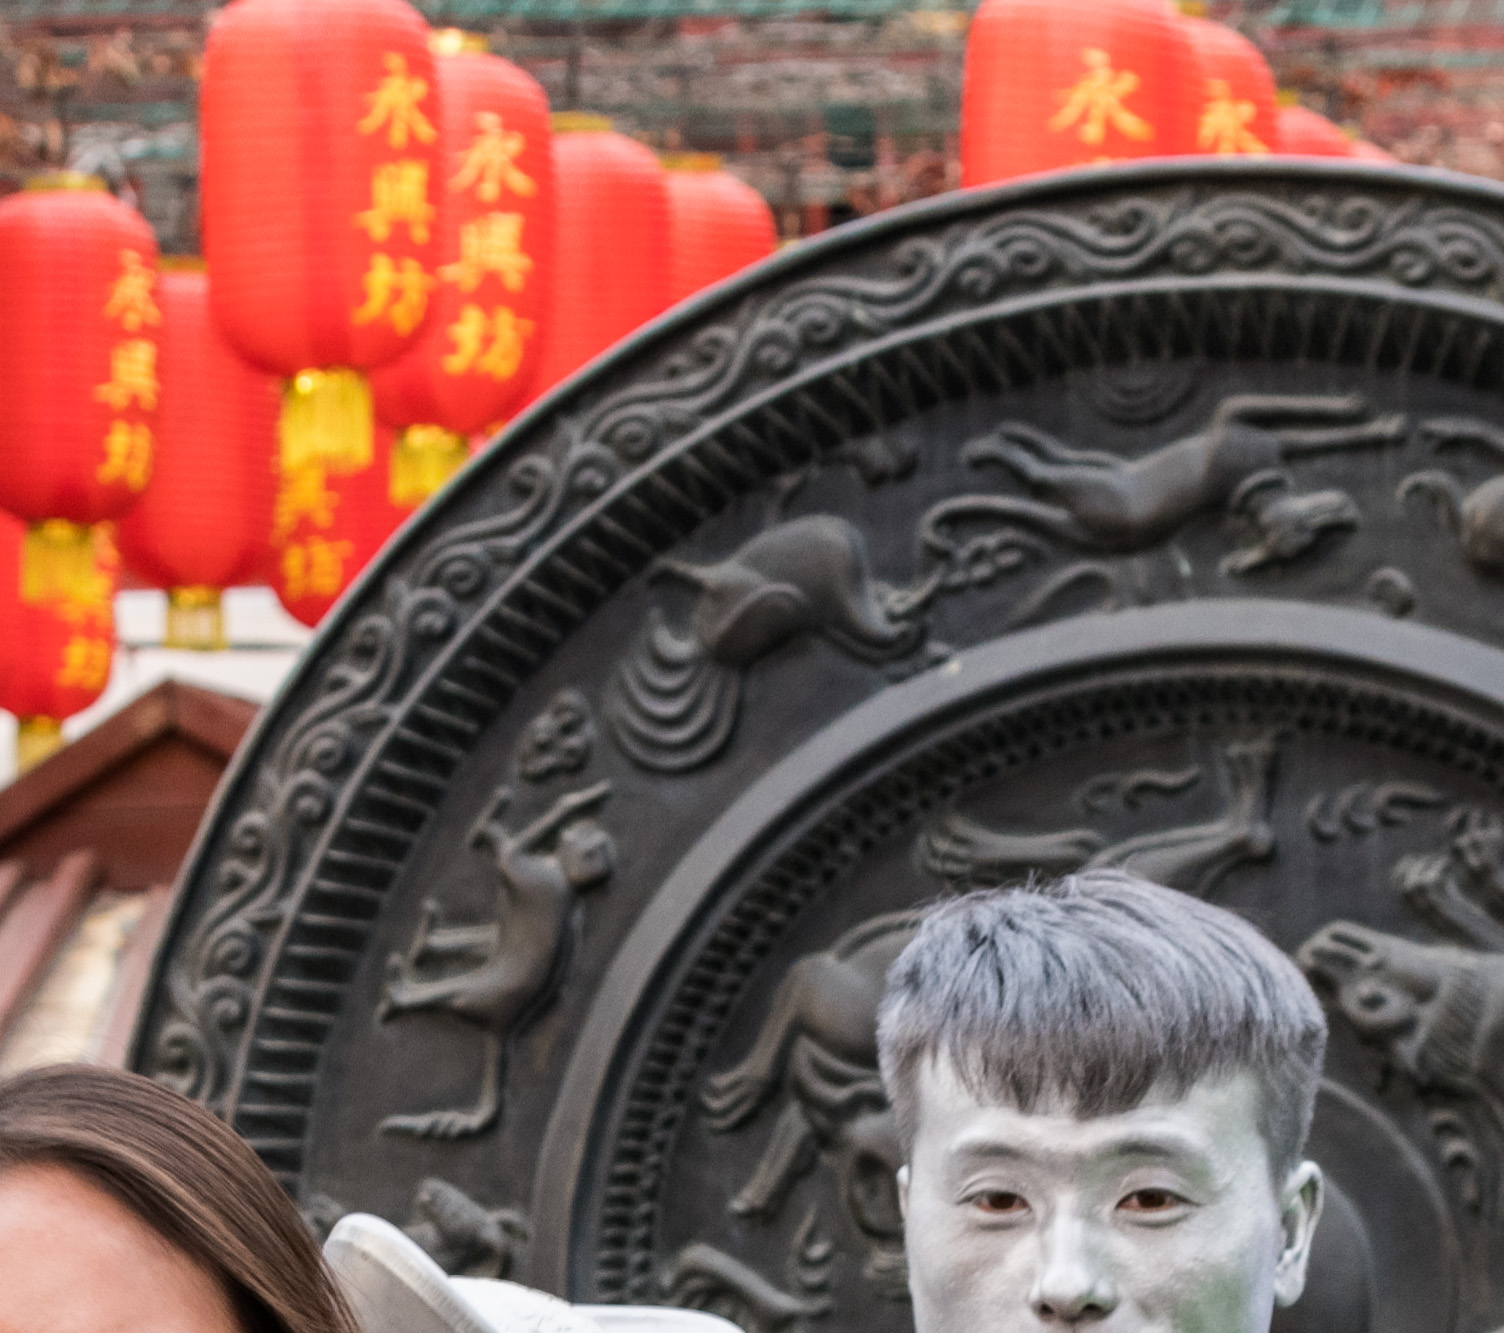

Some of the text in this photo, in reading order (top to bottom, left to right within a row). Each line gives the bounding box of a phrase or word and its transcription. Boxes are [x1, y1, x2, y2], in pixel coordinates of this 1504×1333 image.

[354, 52, 439, 339] 永興坊
[1047, 47, 1156, 148] 永
[95, 249, 162, 494] 永興坊
[439, 110, 538, 382] 永興坊
